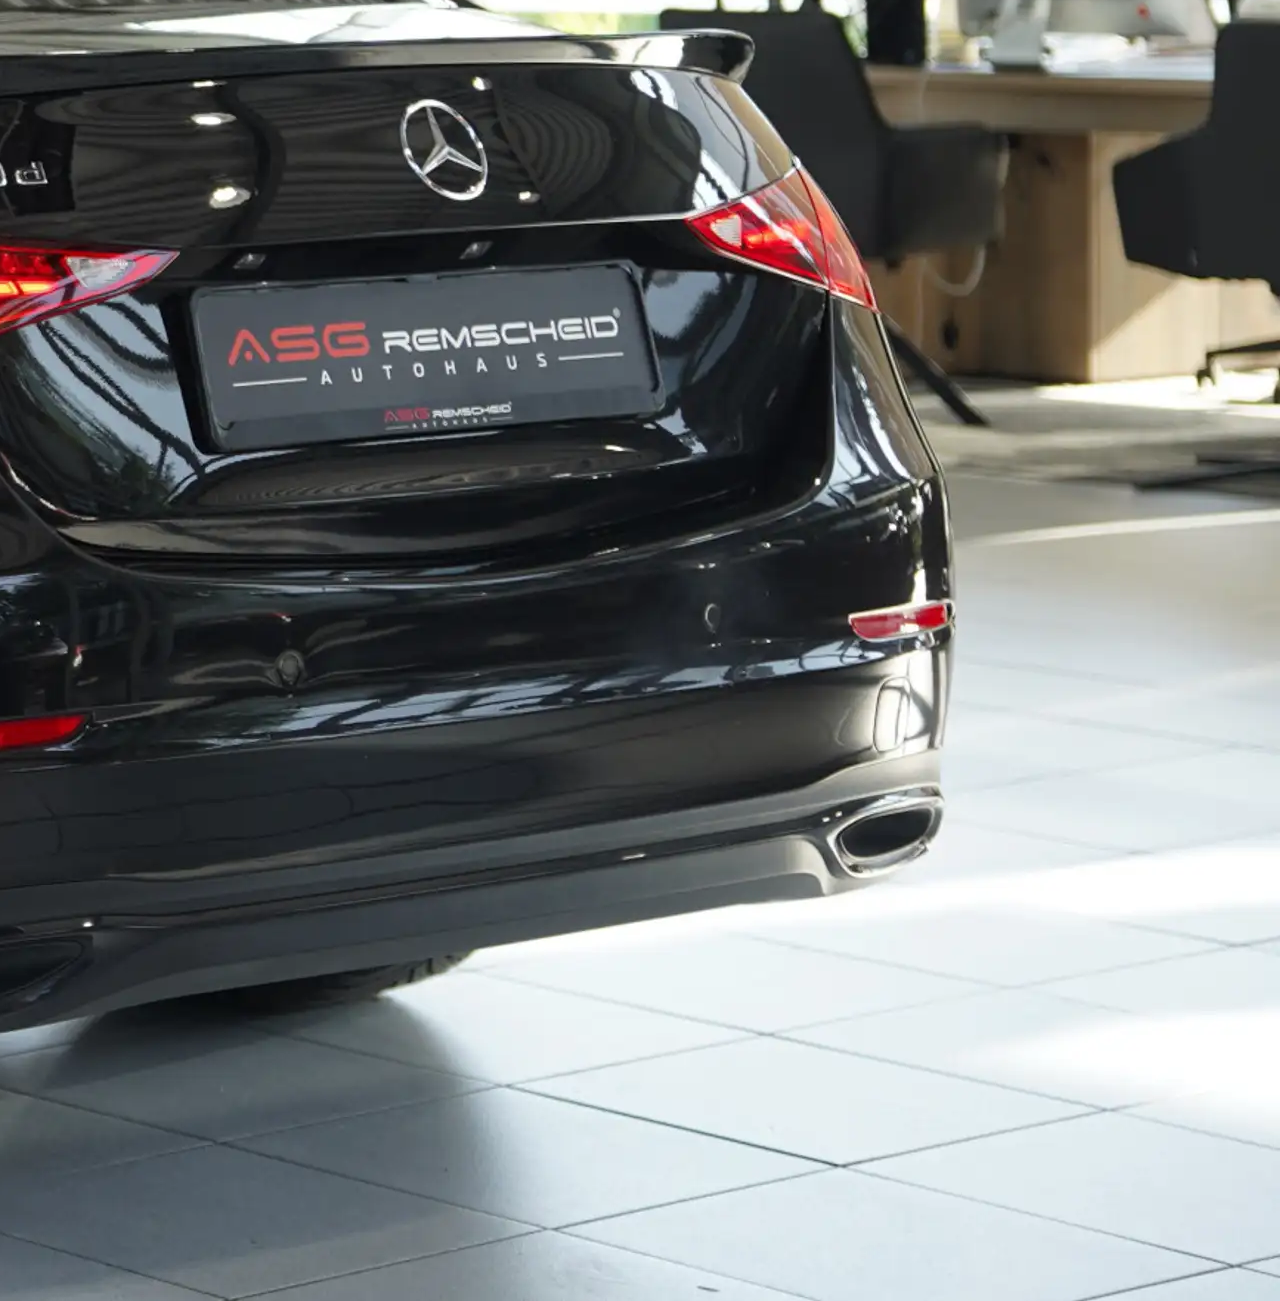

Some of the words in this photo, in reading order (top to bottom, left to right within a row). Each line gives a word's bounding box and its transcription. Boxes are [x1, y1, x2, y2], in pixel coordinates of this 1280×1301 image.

[15, 161, 48, 185] d
[228, 321, 371, 366] ASG
[320, 352, 548, 386] AUTOHAUS
